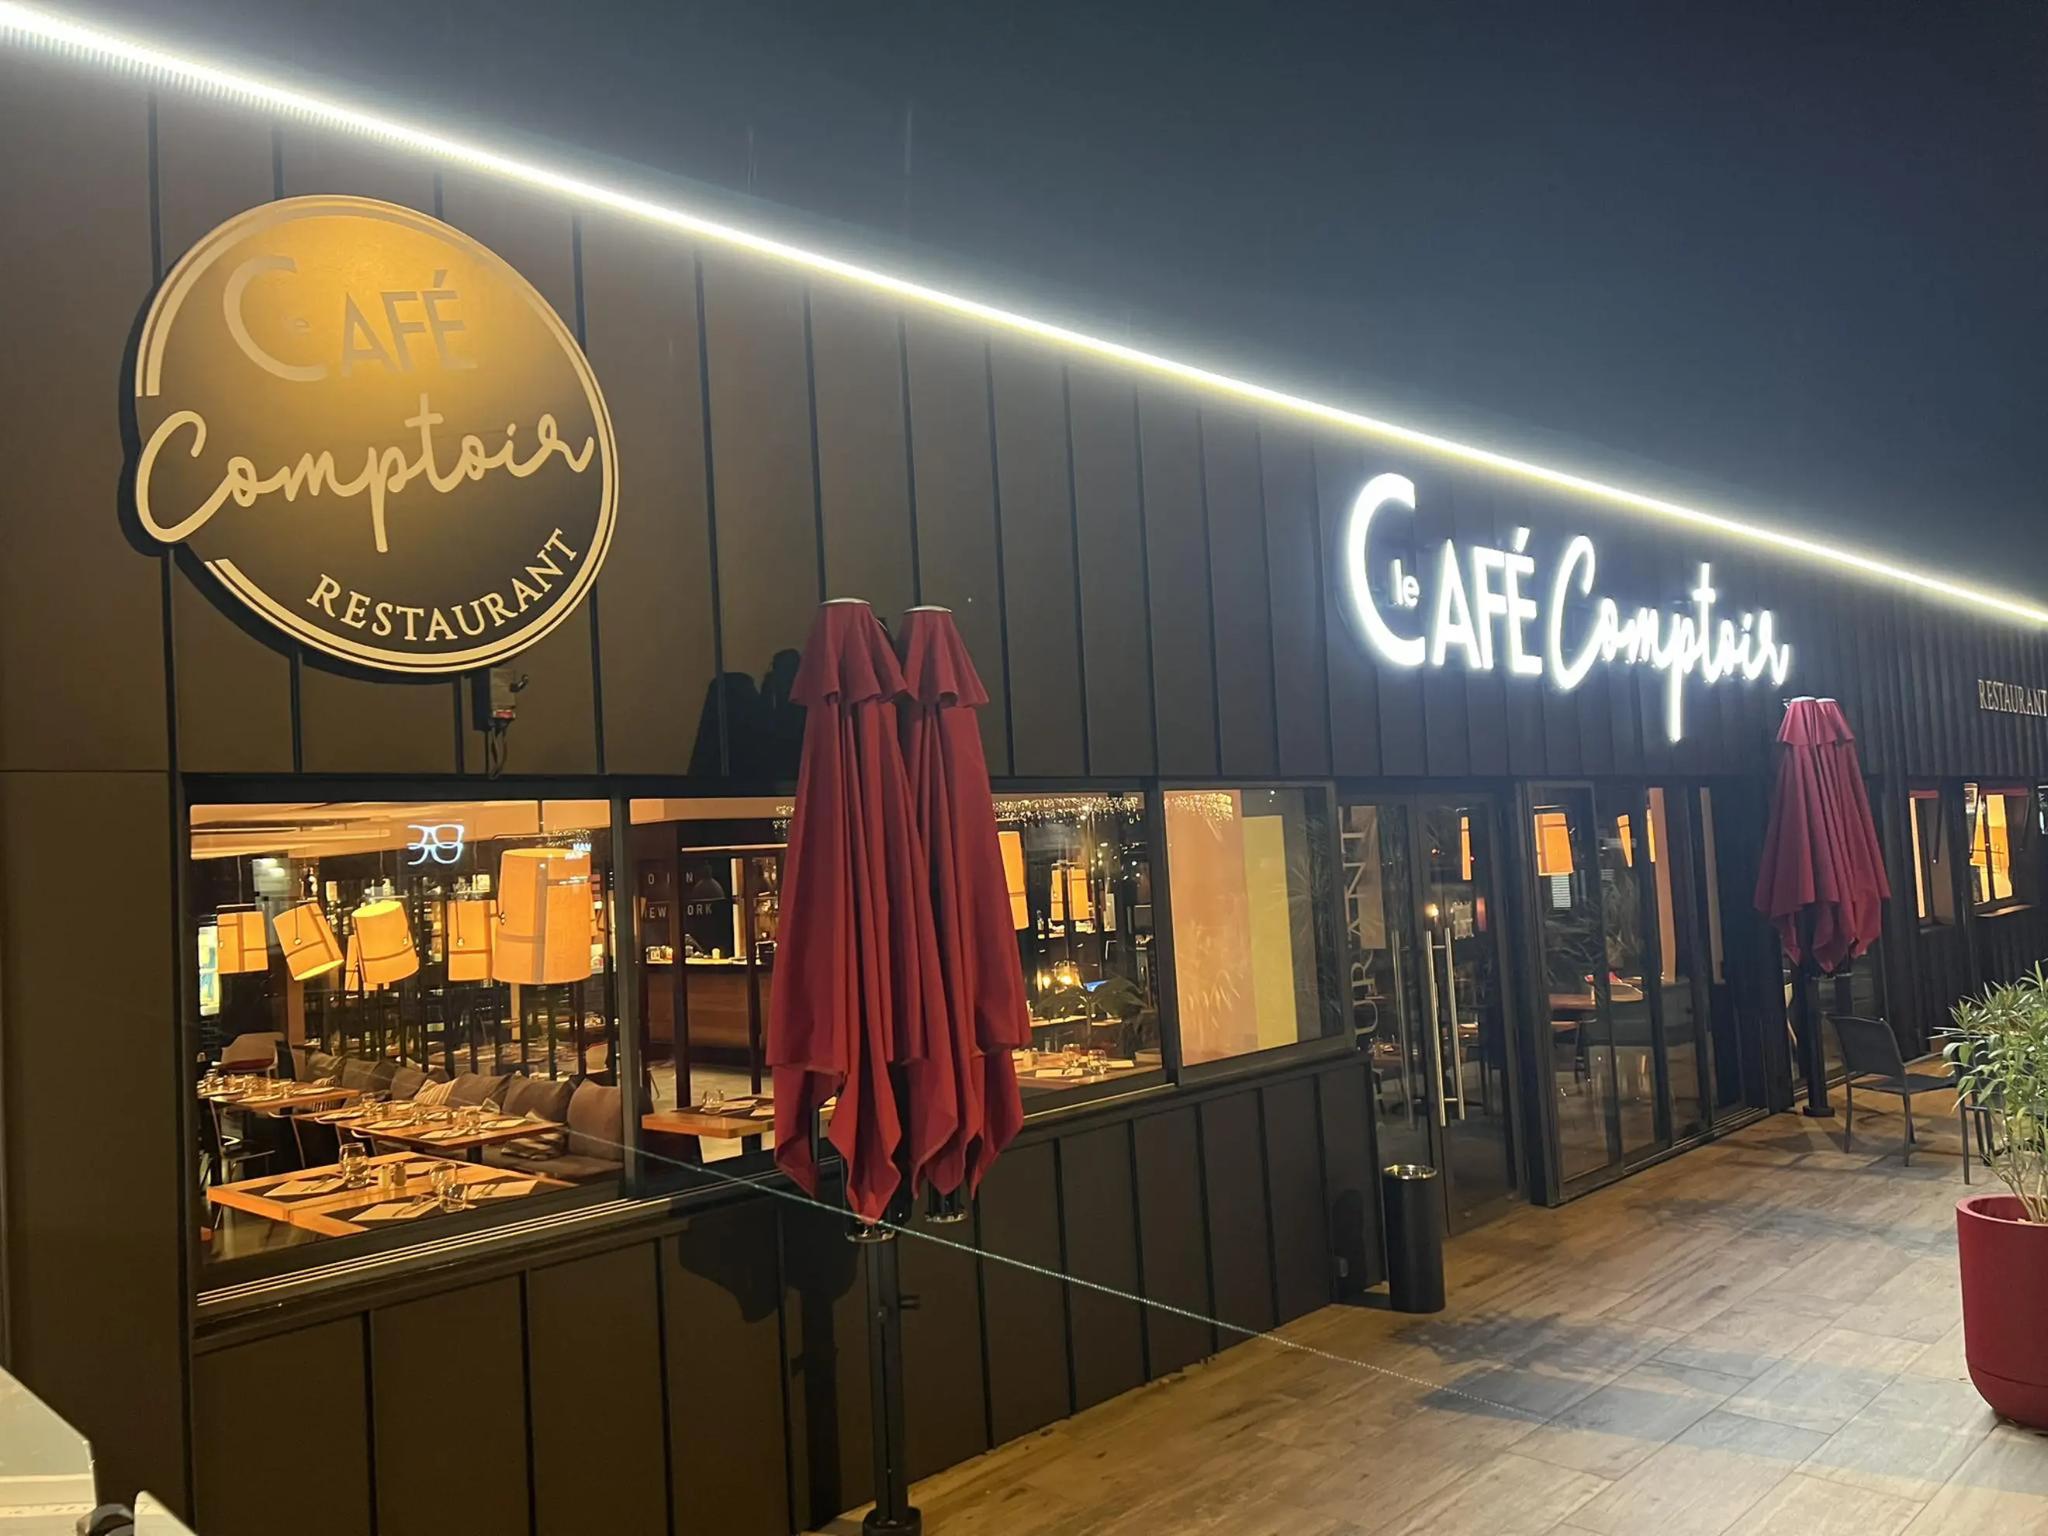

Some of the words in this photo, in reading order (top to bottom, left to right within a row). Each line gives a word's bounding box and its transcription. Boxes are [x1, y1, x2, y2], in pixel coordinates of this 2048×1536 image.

[222, 255, 477, 382] CAFÉ
[135, 392, 595, 553] Comptoir
[306, 527, 578, 642] RESTAURANT
[1347, 471, 1543, 676] CAFÉ
[1390, 557, 1420, 608] le
[1551, 534, 1790, 743] Comptoir
[1977, 679, 2048, 717] RESTAURANT
